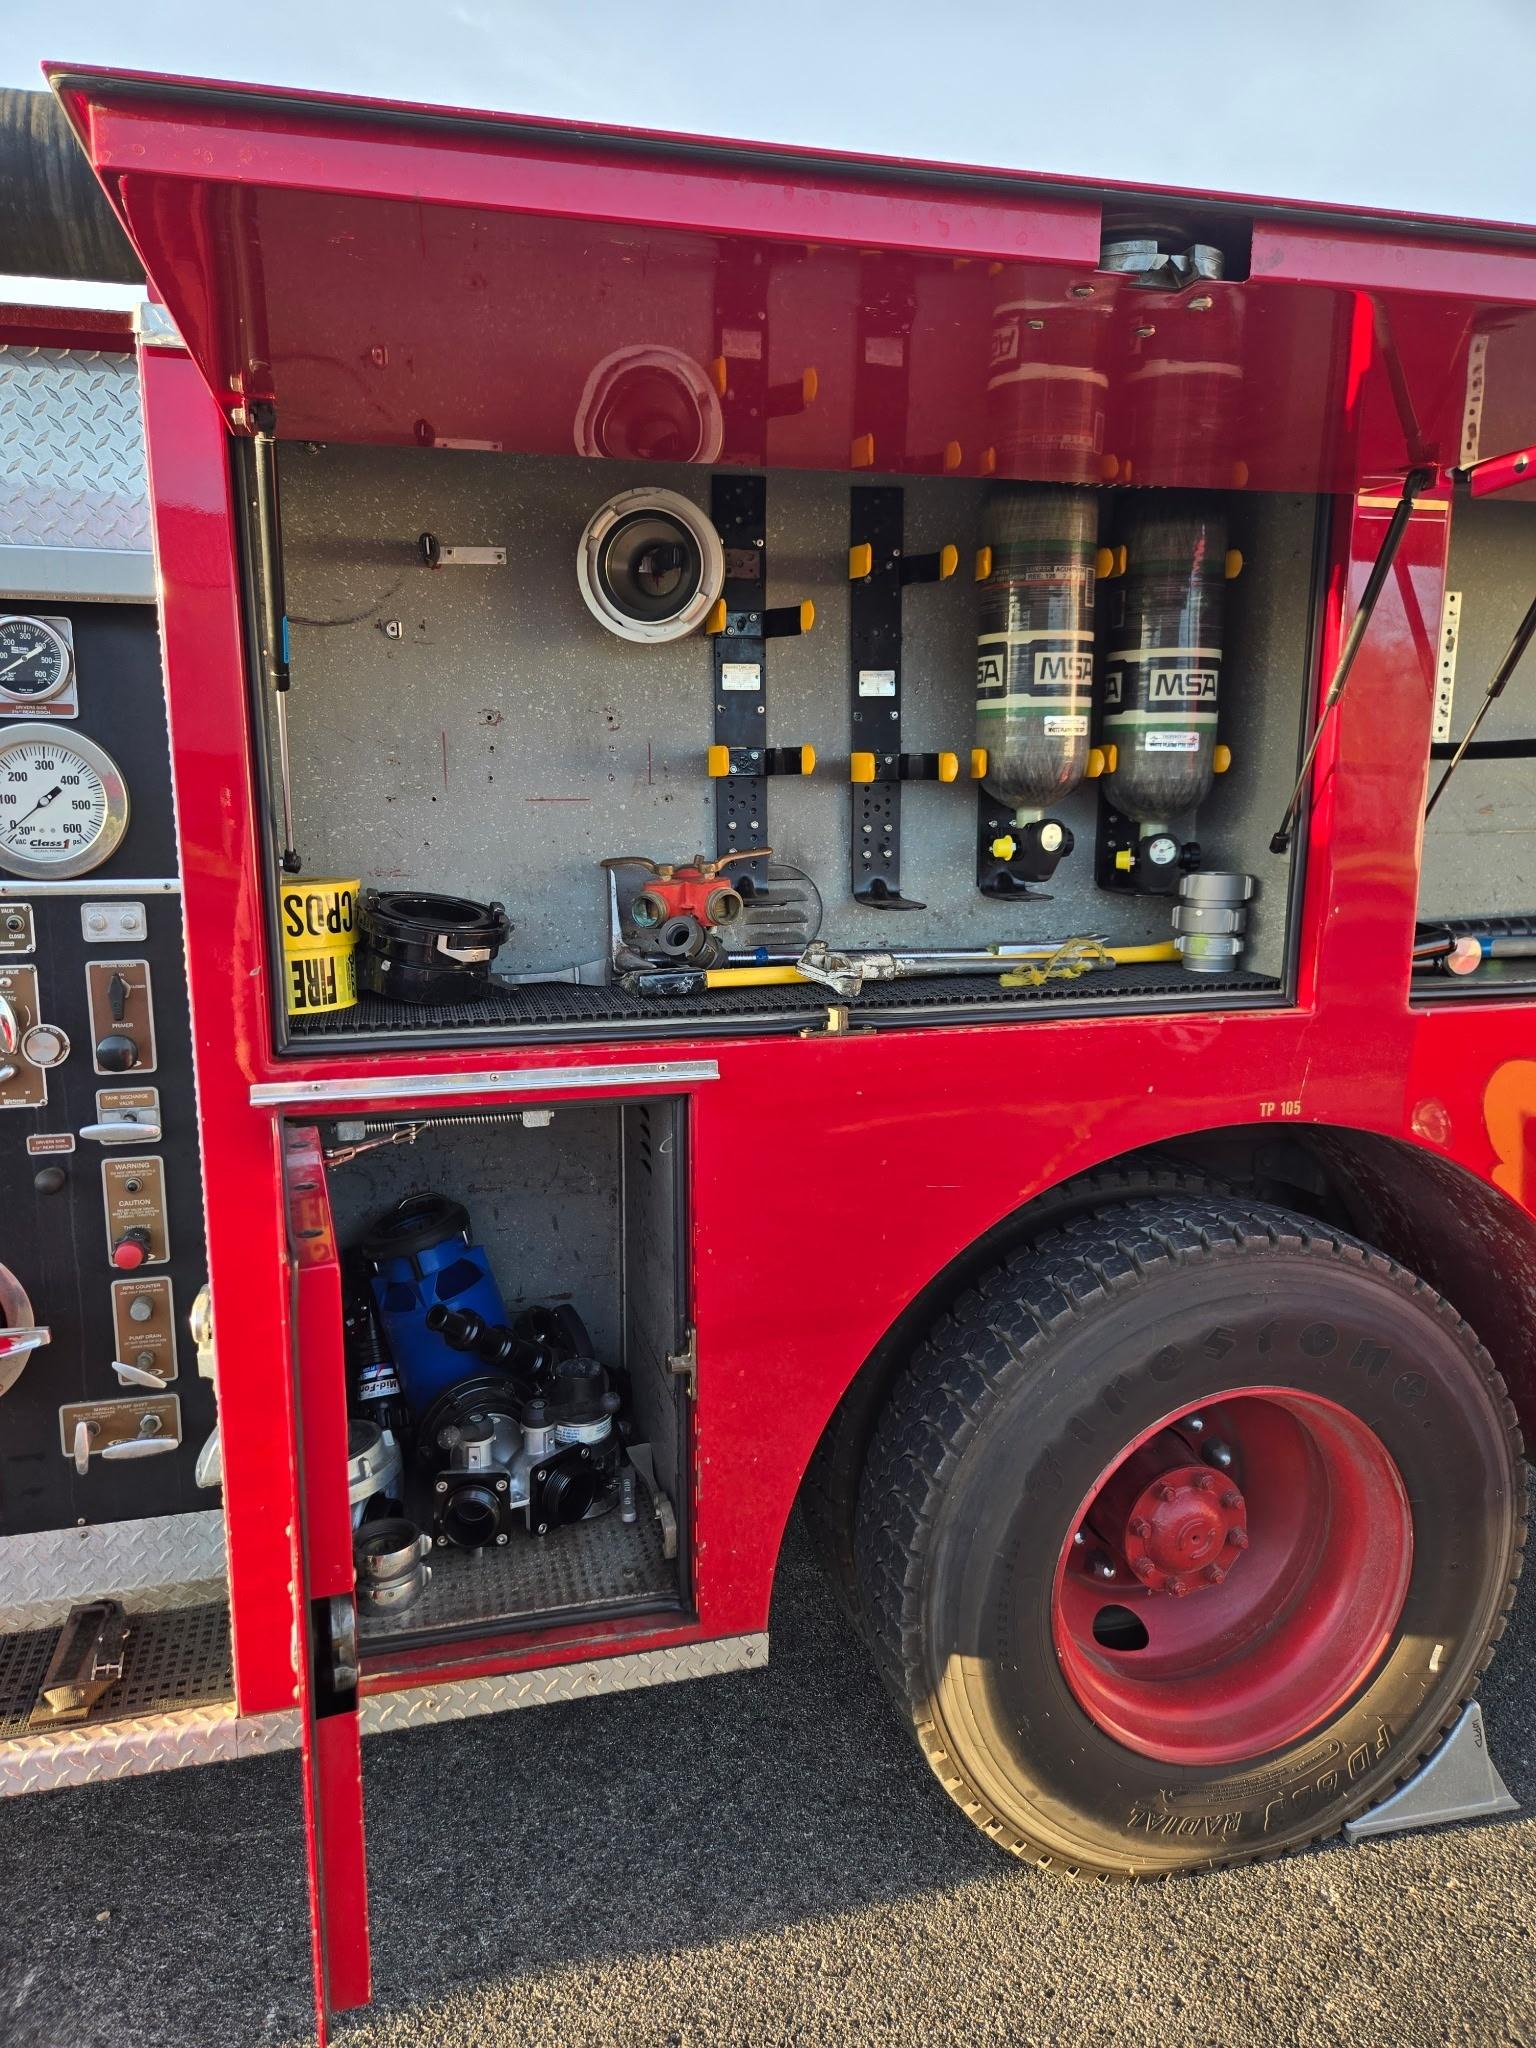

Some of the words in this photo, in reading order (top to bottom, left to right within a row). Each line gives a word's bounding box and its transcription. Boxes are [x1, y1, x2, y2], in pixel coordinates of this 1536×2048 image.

[19, 632, 31, 640] 300
[1040, 657, 1093, 681] MSA
[1155, 673, 1217, 697] MSA
[34, 760, 54, 771] 300
[7, 771, 28, 782] 200
[60, 775, 80, 785] 400
[71, 800, 91, 810] 500
[9, 819, 17, 830] 0
[63, 823, 82, 834] 600
[291, 956, 338, 1008] FIRE
[1260, 1102, 1275, 1117] TP
[1280, 1101, 1301, 1116] 105
[114, 1162, 150, 1170] WARNING
[118, 1199, 151, 1207] CAUTION
[1126, 1808, 1242, 1836] RADIAL
